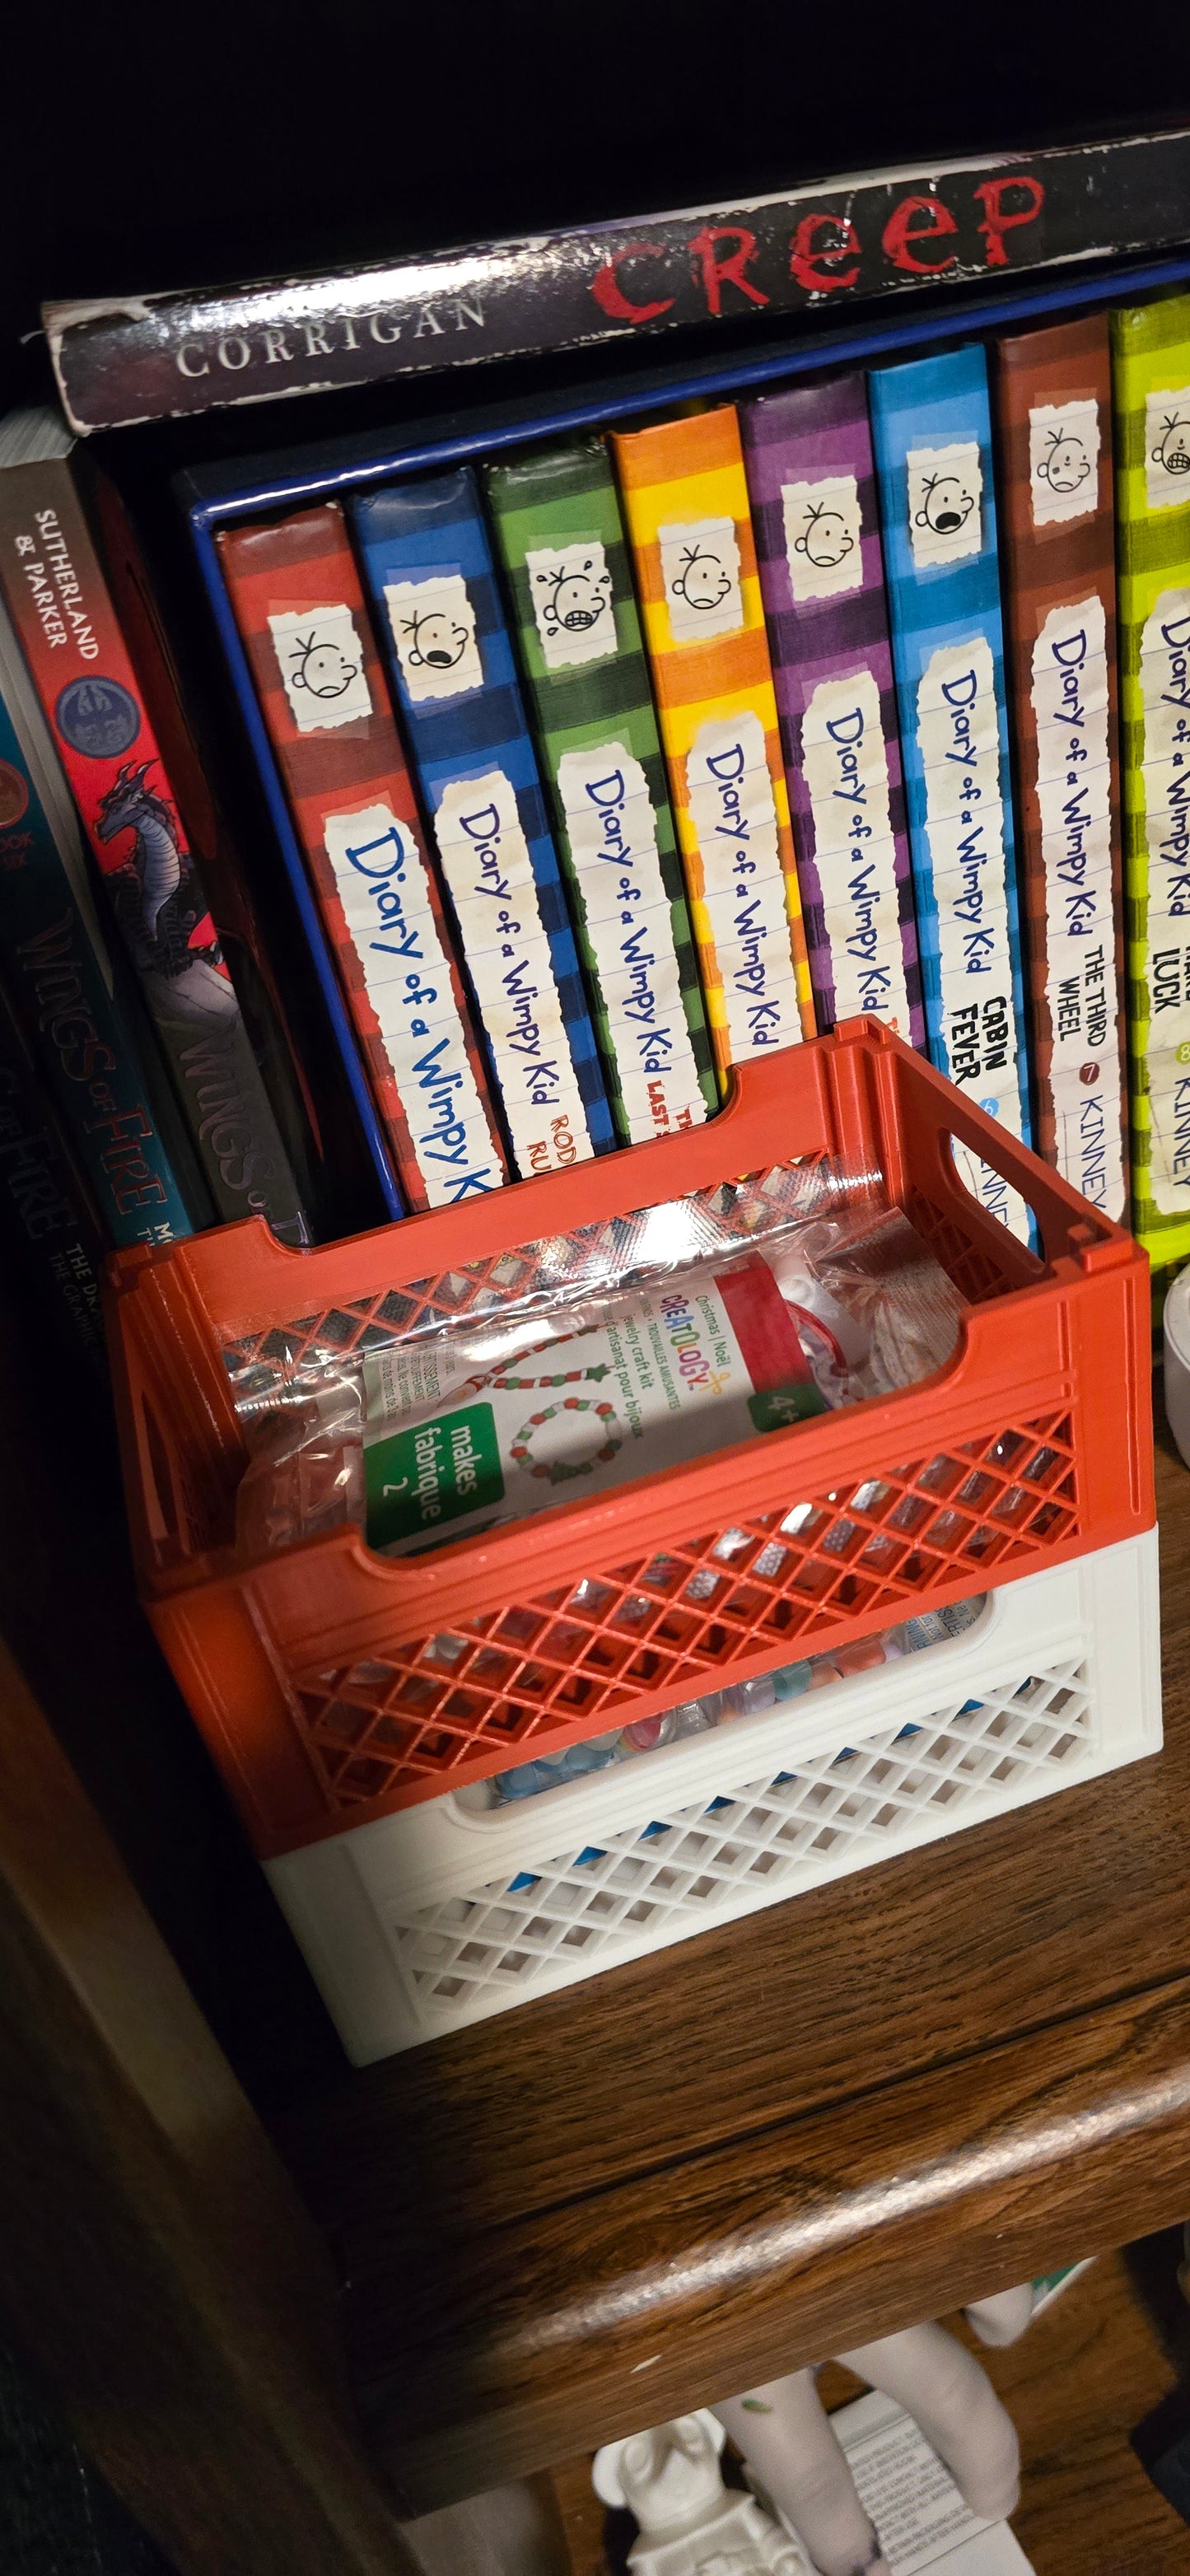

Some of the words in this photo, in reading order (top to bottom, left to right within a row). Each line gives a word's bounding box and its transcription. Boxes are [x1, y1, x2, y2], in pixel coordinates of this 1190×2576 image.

[175, 297, 487, 377] CORRIGAN
[14, 535, 37, 558] &
[24, 562, 68, 648] PARKER
[35, 509, 100, 660] SUTHERLAND
[1052, 629, 1087, 727] Diary
[941, 670, 978, 767] Diary
[825, 707, 866, 804] Diary
[1066, 738, 1087, 762] of
[706, 743, 750, 840] Diary
[959, 777, 982, 801] of
[1067, 772, 1078, 786] a
[585, 769, 633, 867] Diary
[848, 814, 871, 838] of
[961, 810, 972, 824] a
[1056, 787, 1091, 886] Wimpy
[459, 803, 511, 900] Diary
[732, 851, 756, 873] of
[852, 848, 863, 862] a
[952, 826, 987, 923] Wimpy
[345, 827, 423, 959] Diary
[616, 877, 640, 901] of
[736, 884, 748, 897] a
[496, 911, 520, 936] of
[621, 911, 634, 924] a
[845, 864, 880, 961] Wimpy
[1066, 890, 1096, 936] Kid
[502, 944, 511, 958] a
[733, 899, 767, 996] Wimpy
[963, 927, 995, 974] Kid
[1085, 945, 1104, 987] THE
[402, 973, 437, 1005] of
[619, 926, 656, 1024] Wimpy
[856, 965, 891, 1011] Kid
[1153, 948, 1180, 1014] LUCK
[413, 1019, 430, 1038] a
[502, 960, 541, 1056] Wimpy
[746, 1001, 780, 1045] Kid
[1057, 977, 1081, 1042] WHEEL
[1085, 987, 1107, 1047] THIRD
[637, 1027, 673, 1073] Kid
[950, 1003, 981, 1085] FEVER
[982, 996, 1009, 1071] CABIN
[16, 906, 116, 1081] WINGS
[84, 1103, 167, 1215] FIRE
[523, 1060, 560, 1105] Kid
[1083, 1065, 1093, 1082] 7
[179, 1024, 276, 1190] WINGS
[411, 1038, 469, 1164] Wimpy
[647, 1080, 670, 1125] LAST
[66, 1243, 92, 1280] THE
[619, 1313, 641, 1344] jewelry
[695, 1295, 721, 1335] Christmas
[714, 1341, 731, 1367] Noël
[632, 1346, 651, 1369] craft
[639, 1370, 653, 1389] kit
[646, 1323, 668, 1365] TROUVAILLES
[658, 1365, 681, 1410] AMUSANTES
[614, 1369, 634, 1398] pour
[623, 1399, 644, 1438] bijoux
[768, 1396, 800, 1422] 4+
[411, 1427, 445, 1520] fabrique
[450, 1426, 483, 1496] makes
[383, 1477, 408, 1496] 2
